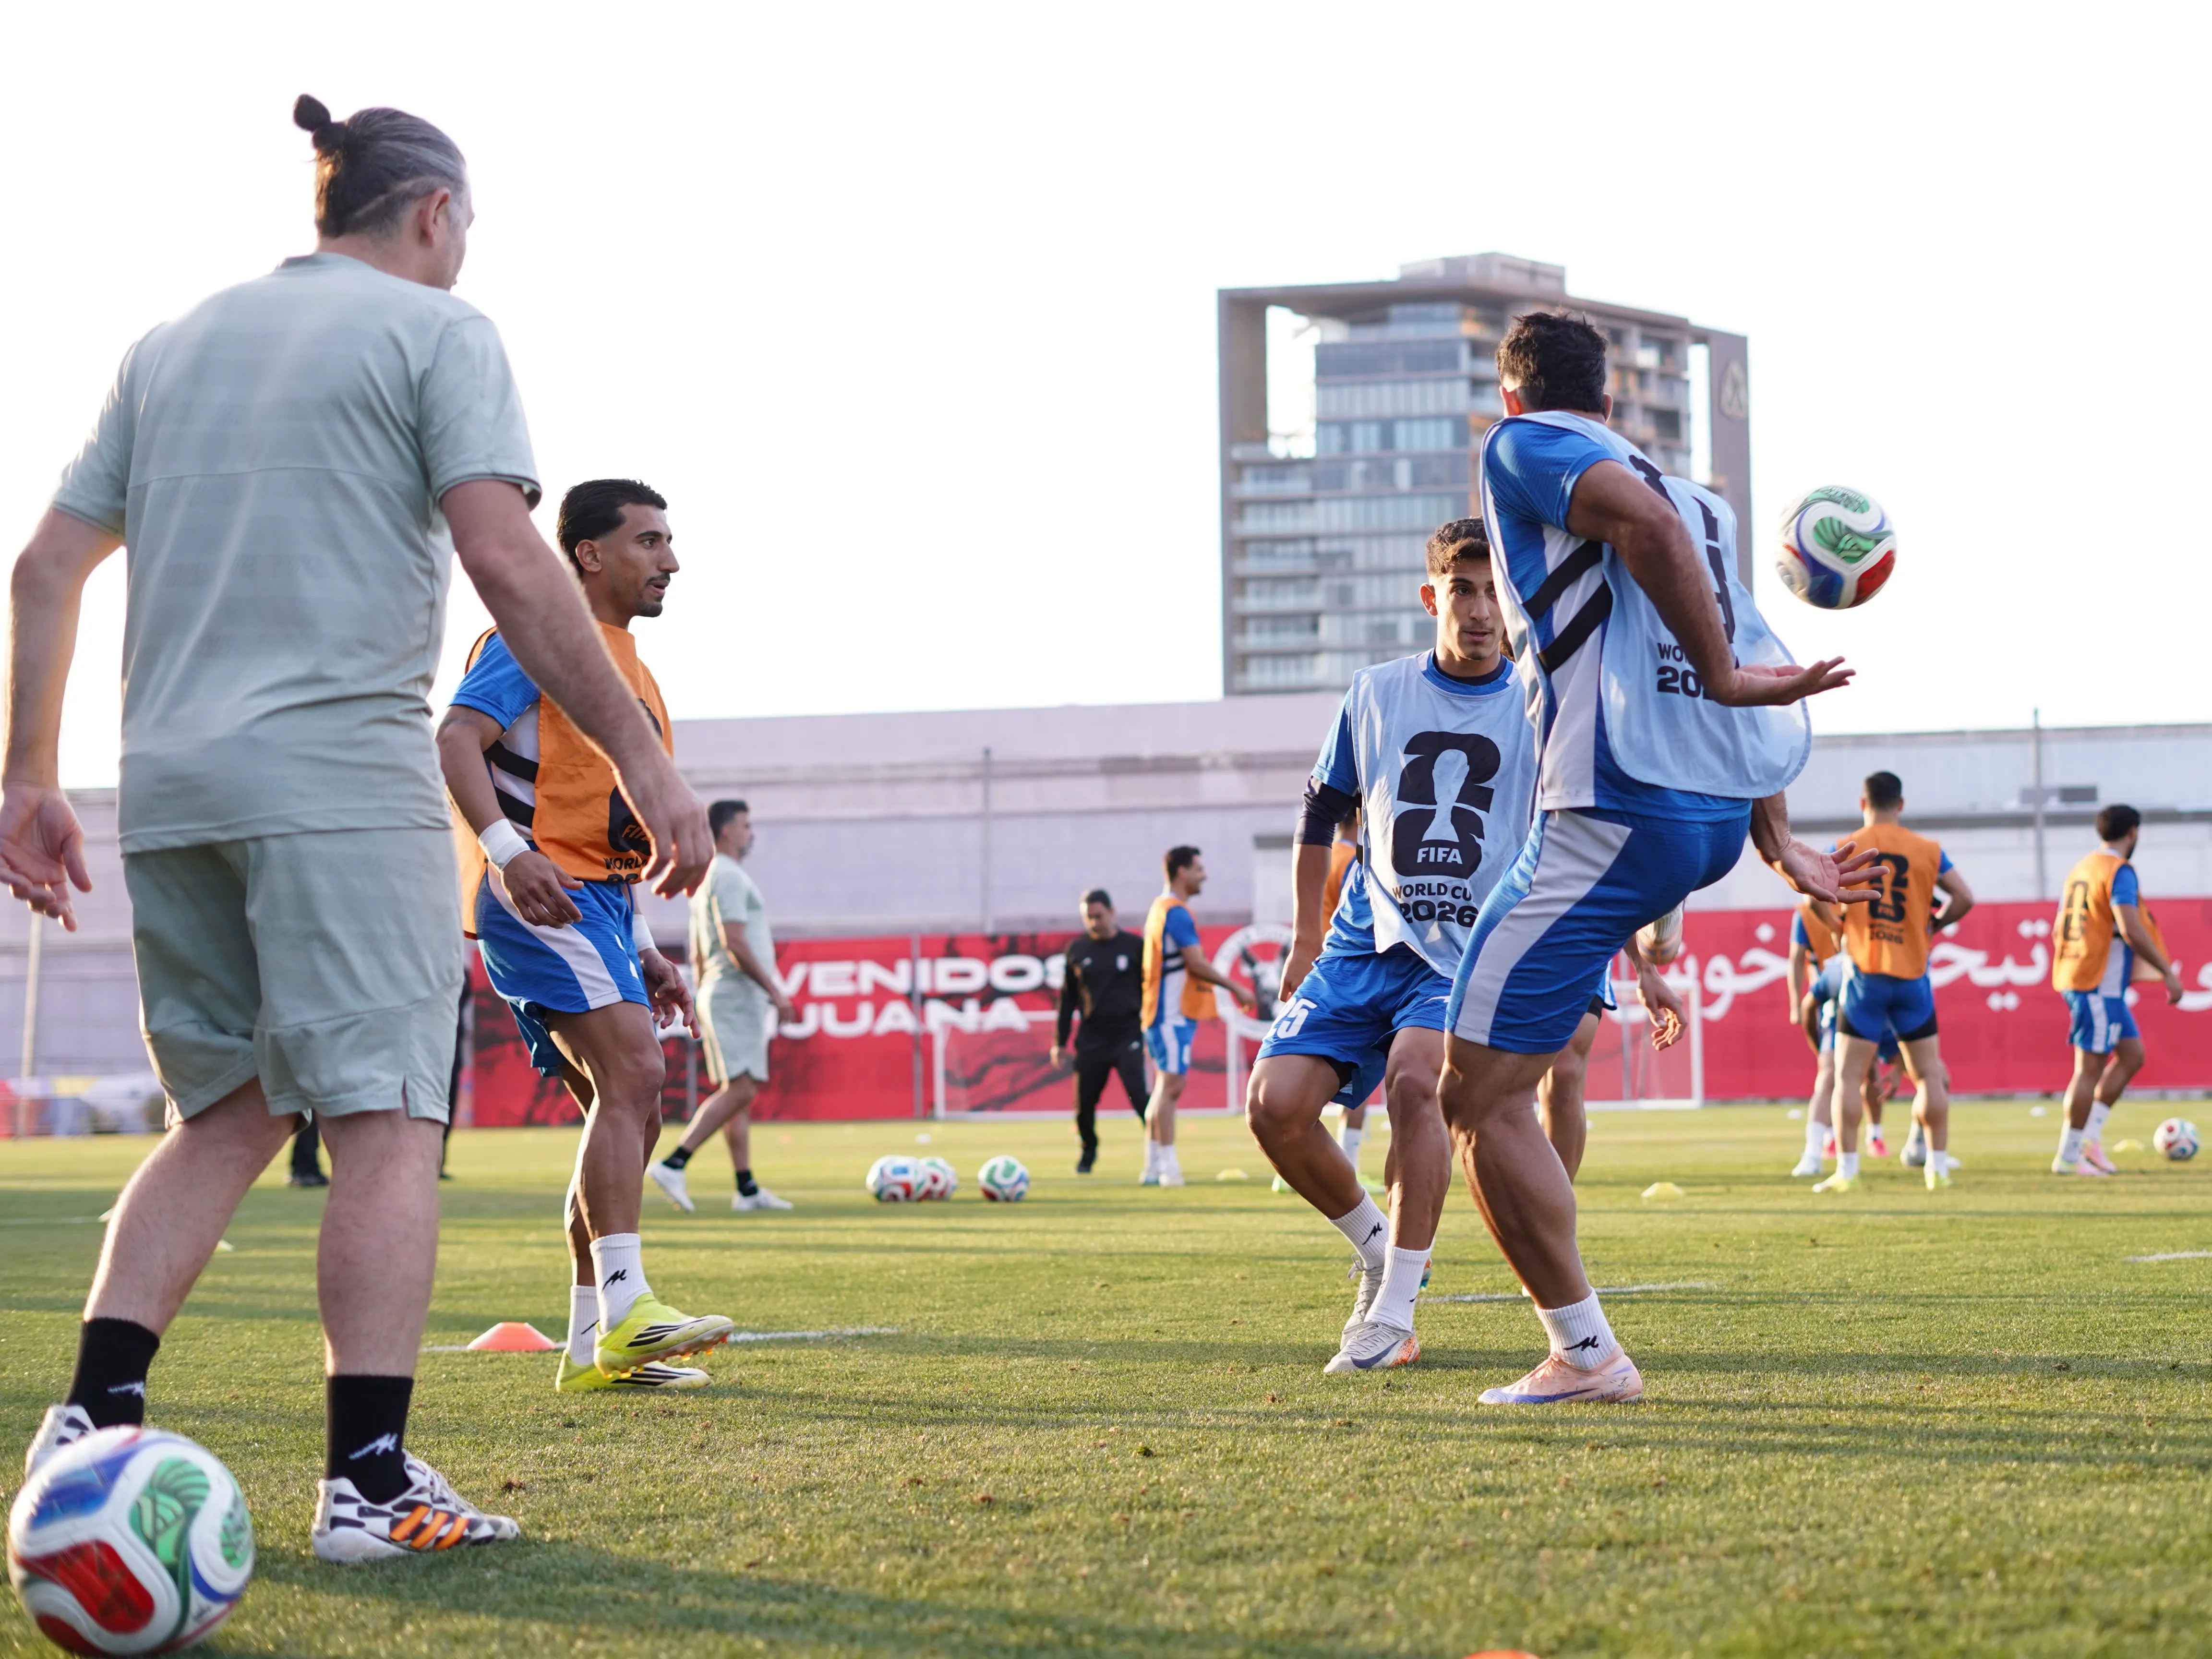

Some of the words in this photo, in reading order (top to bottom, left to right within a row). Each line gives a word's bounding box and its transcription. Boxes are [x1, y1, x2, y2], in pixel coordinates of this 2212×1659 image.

[1417, 847, 1463, 865] FIFA
[1392, 883, 1448, 900] WORLD
[1451, 886, 1472, 902] CU
[1400, 899, 1479, 928] 2026
